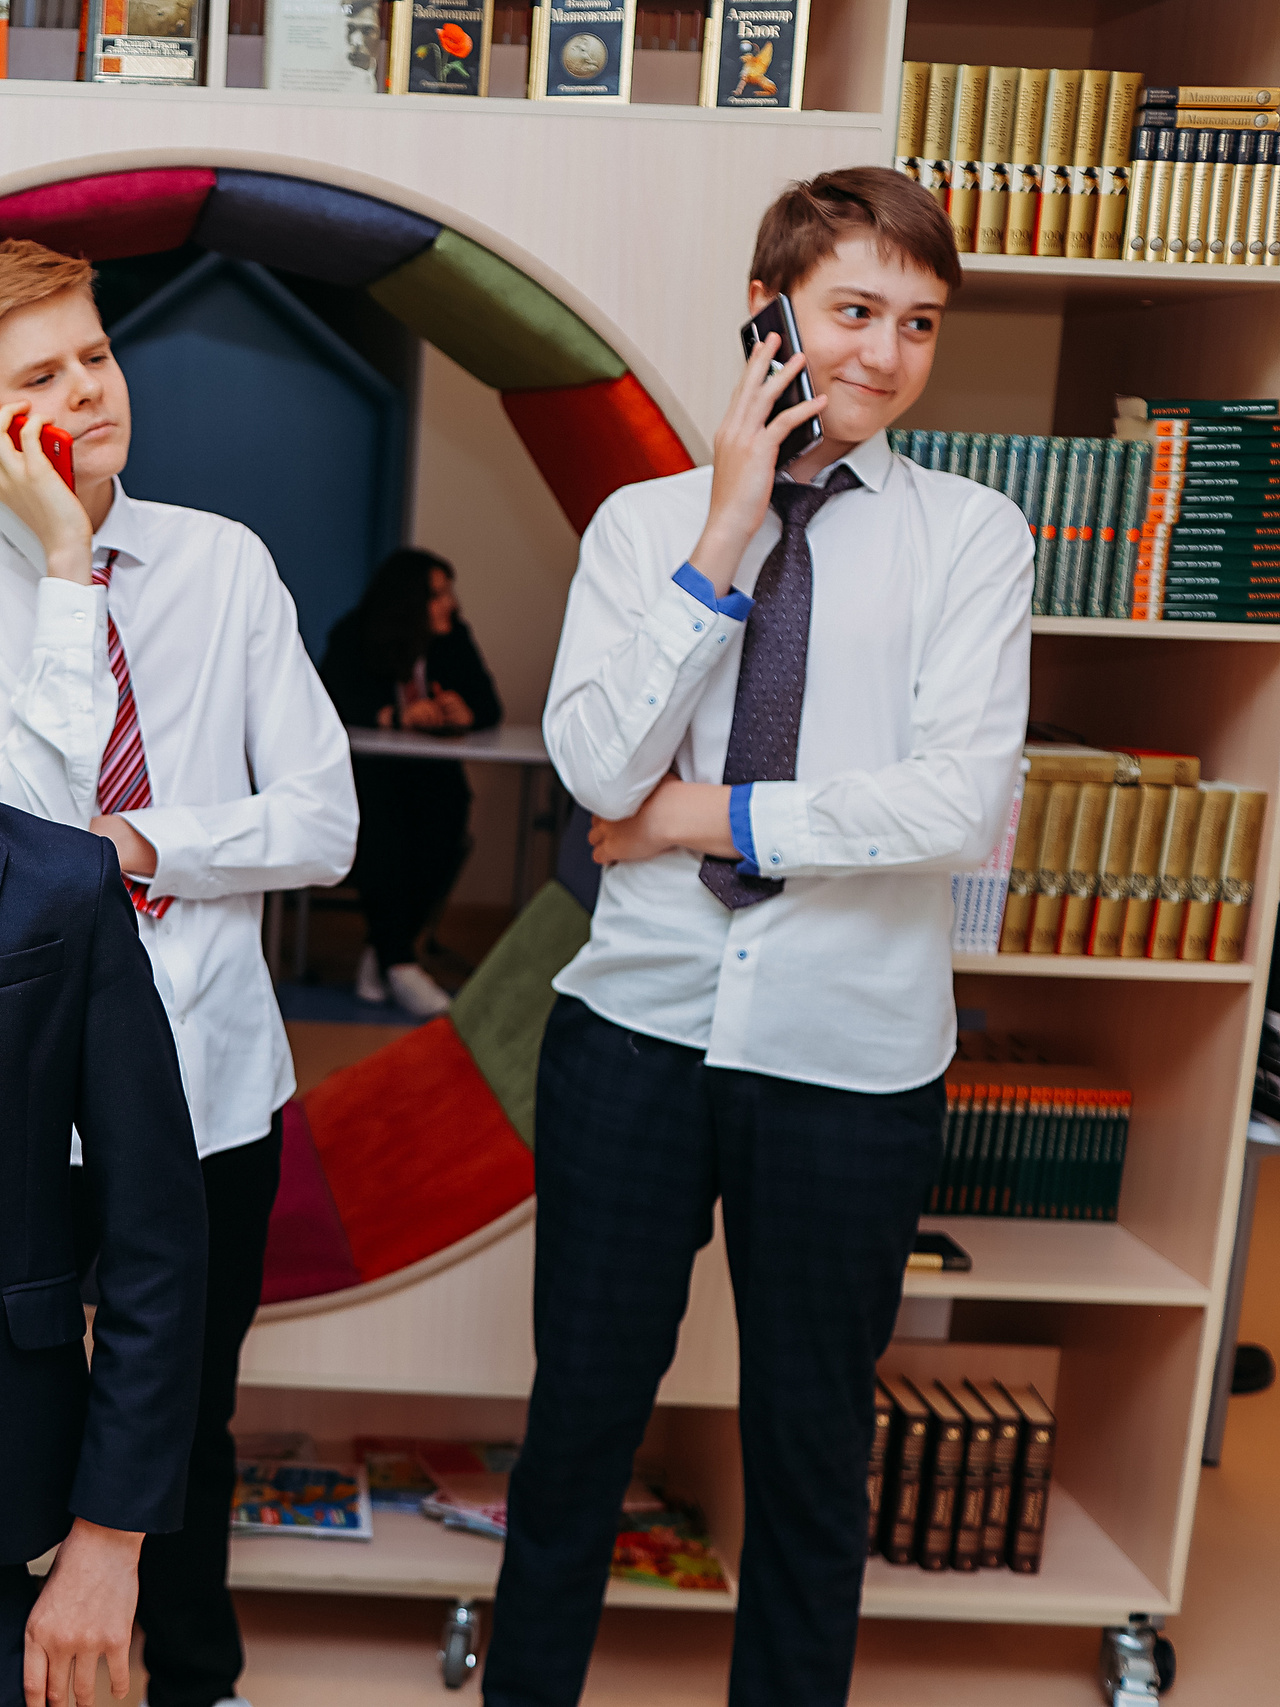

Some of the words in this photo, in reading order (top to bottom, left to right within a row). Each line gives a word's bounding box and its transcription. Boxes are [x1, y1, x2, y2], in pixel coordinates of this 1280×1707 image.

[413, 4, 484, 21] Заболоцкий
[551, 7, 624, 23] Маяковский
[726, 8, 793, 24] Александр
[738, 21, 781, 38] Блок
[937, 76, 951, 150] МАЯКОВСКИЙ
[968, 77, 983, 149] МАЯКОВСКИЙ
[997, 79, 1012, 152] МАЯКОВСКИЙ
[1026, 80, 1041, 154] МАЯКОВСКИЙ
[1058, 82, 1074, 156] МАЯКОВСКИЙ
[1089, 83, 1104, 157] МАЯКОВСКИЙ
[1118, 83, 1134, 157] МАЯКОВСКИЙ
[1187, 114, 1252, 126] Маяковский
[1189, 91, 1254, 103] Маяковский
